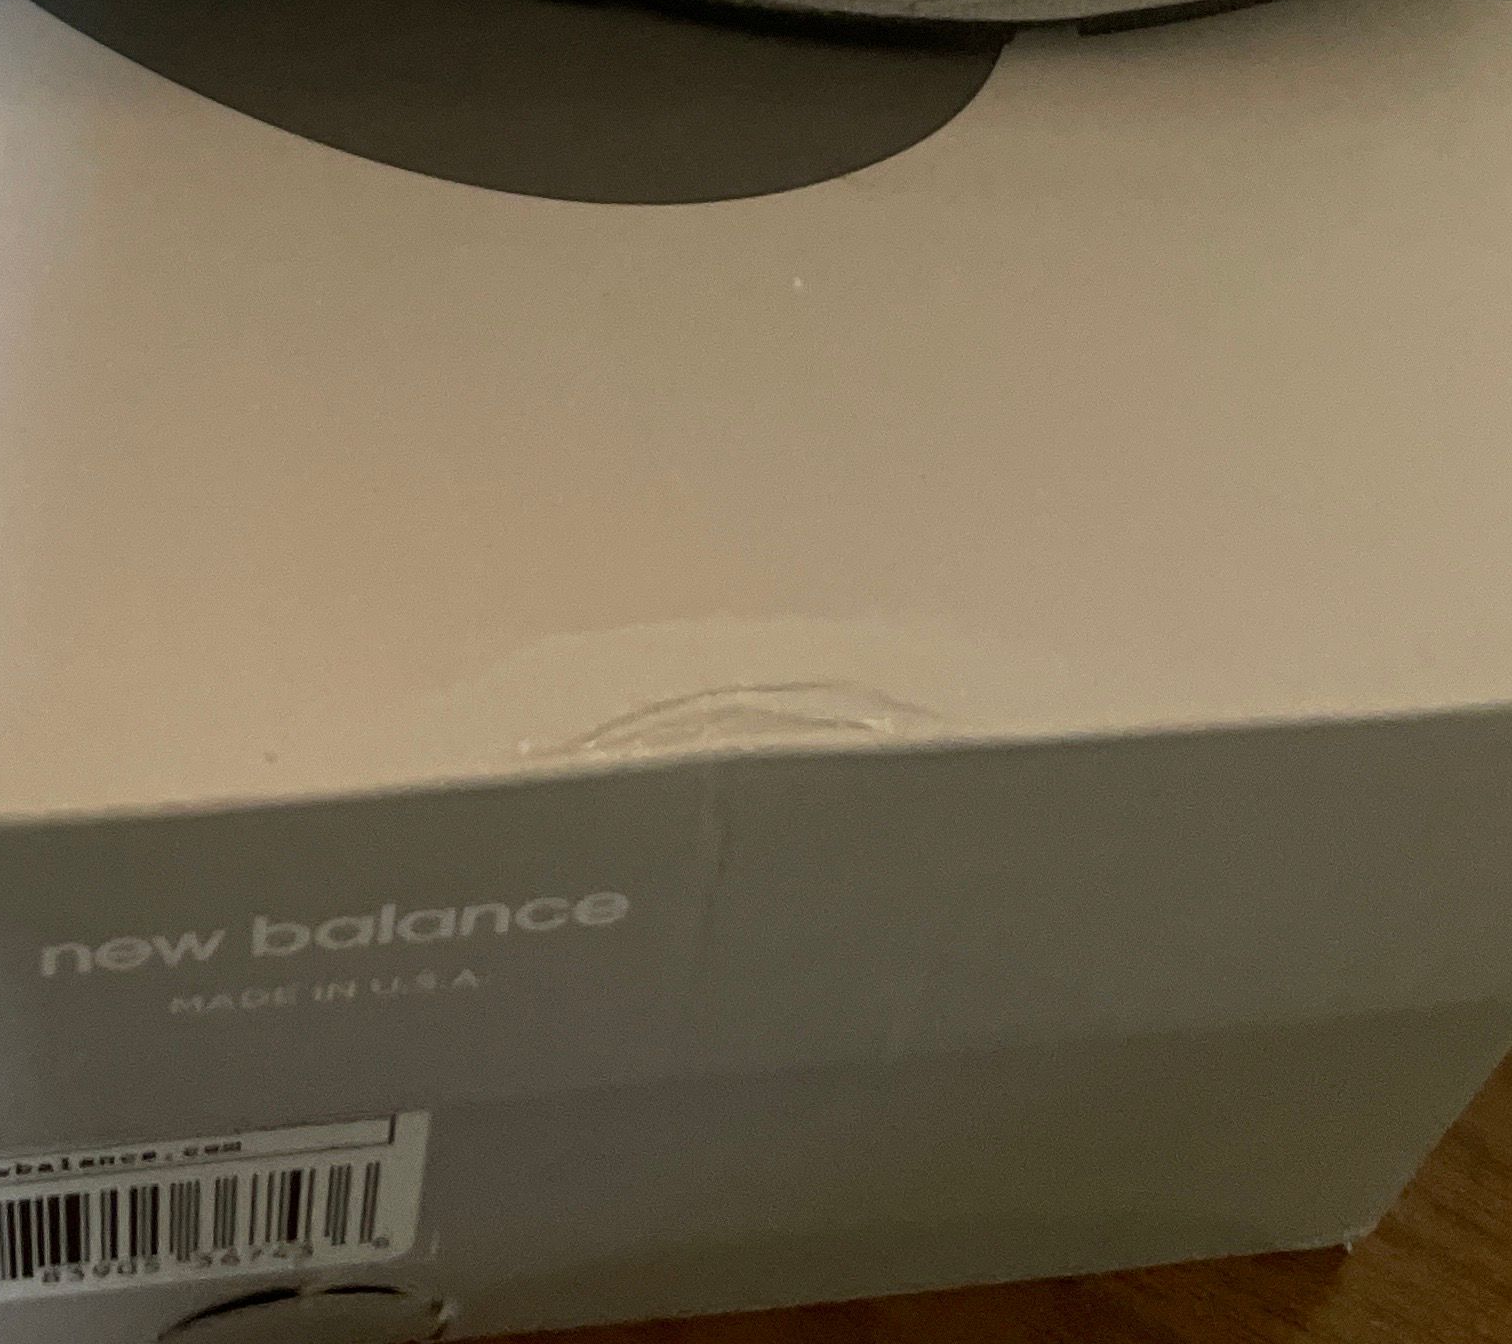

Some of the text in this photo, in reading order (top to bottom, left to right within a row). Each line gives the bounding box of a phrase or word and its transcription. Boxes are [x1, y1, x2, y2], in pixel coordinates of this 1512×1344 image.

[40, 890, 630, 977] new balance
[169, 985, 298, 1013] MADE
[311, 979, 357, 1002] IN
